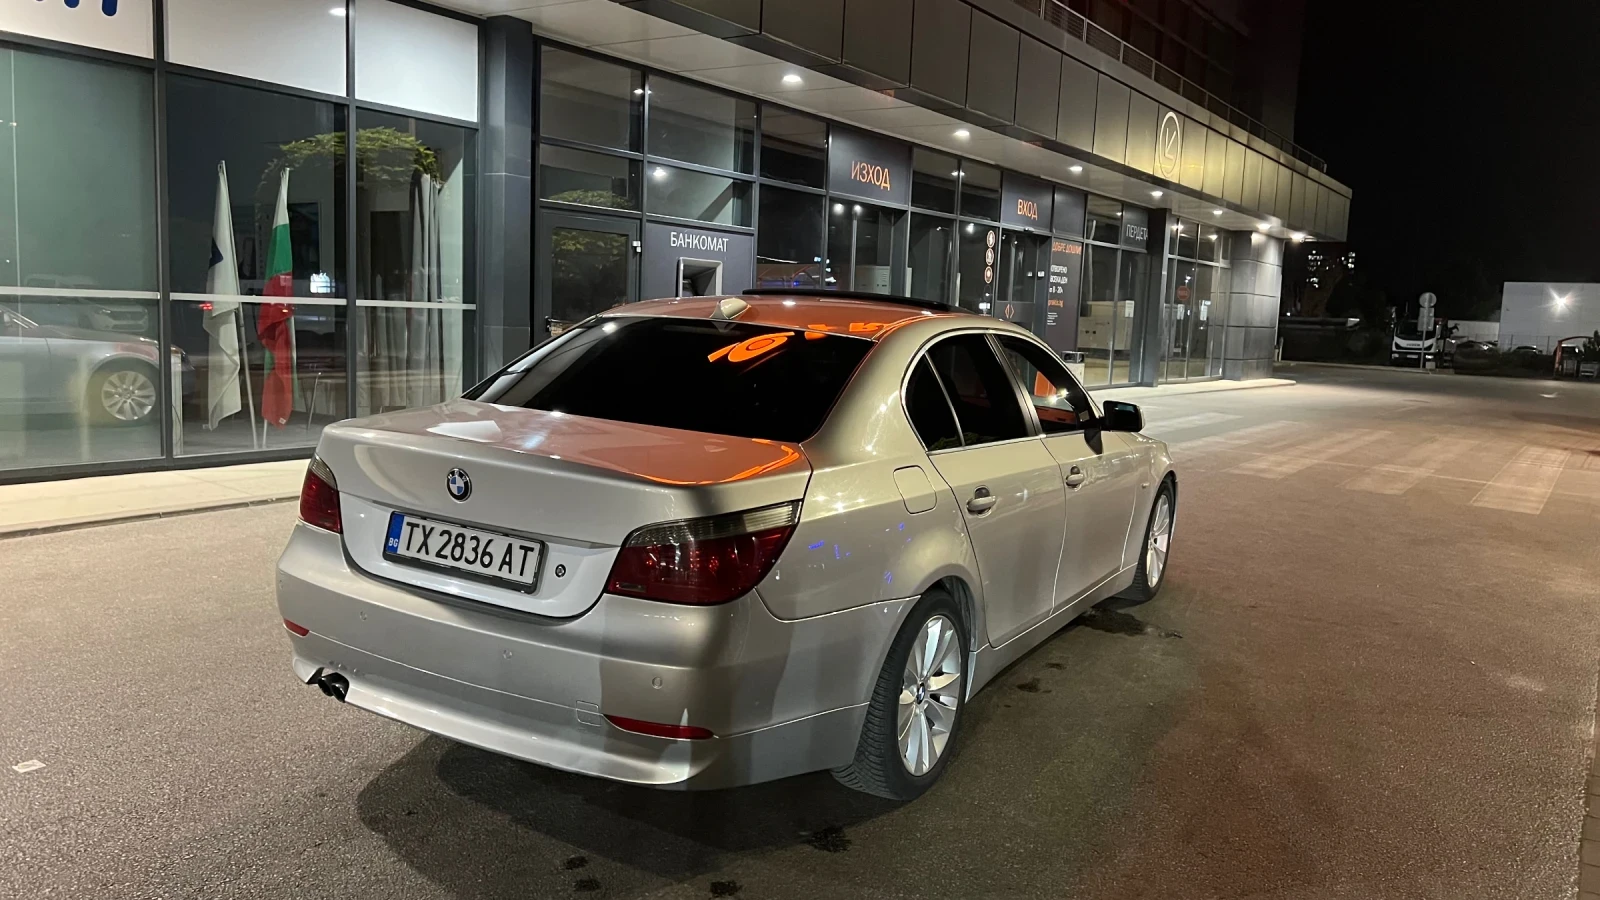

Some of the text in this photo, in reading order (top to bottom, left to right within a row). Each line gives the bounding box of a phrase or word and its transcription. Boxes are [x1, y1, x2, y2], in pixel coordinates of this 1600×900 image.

[851, 160, 890, 191] ИЗХОД
[1017, 198, 1038, 220] ВХОД
[670, 231, 729, 252] БАНКОМАТ
[388, 537, 399, 548] BG
[406, 522, 535, 577] TX 2836 AT
